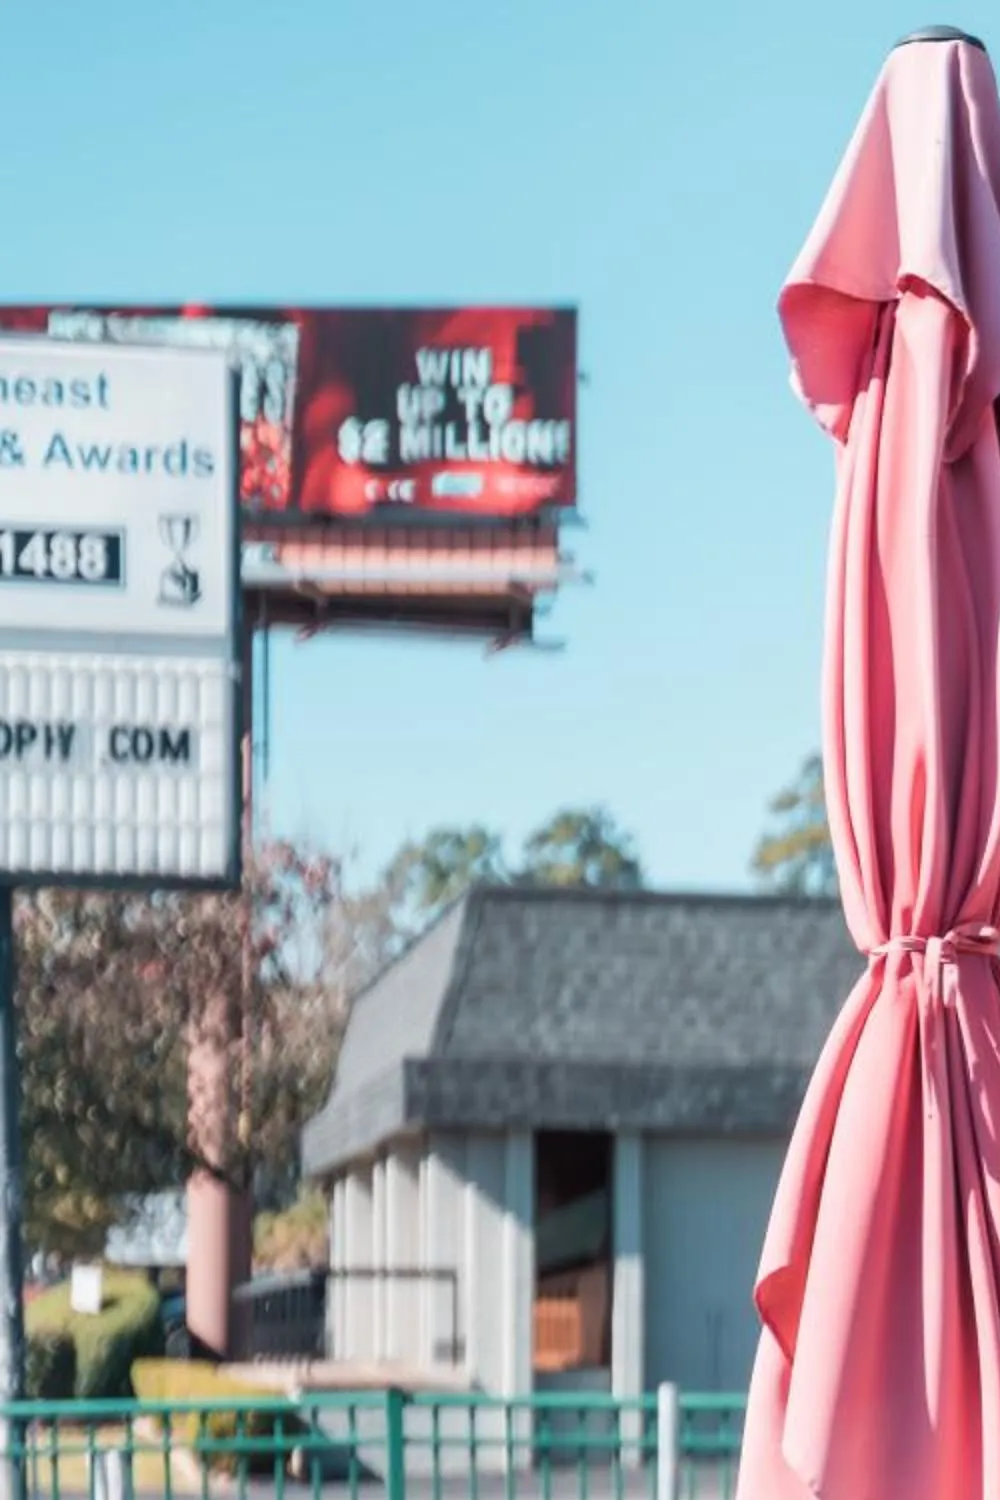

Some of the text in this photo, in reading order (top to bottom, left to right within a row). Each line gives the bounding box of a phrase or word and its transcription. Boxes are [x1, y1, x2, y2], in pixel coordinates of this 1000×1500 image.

[416, 347, 492, 387] WIN
[397, 383, 513, 423] UP TO
[44, 431, 214, 478] Awards
